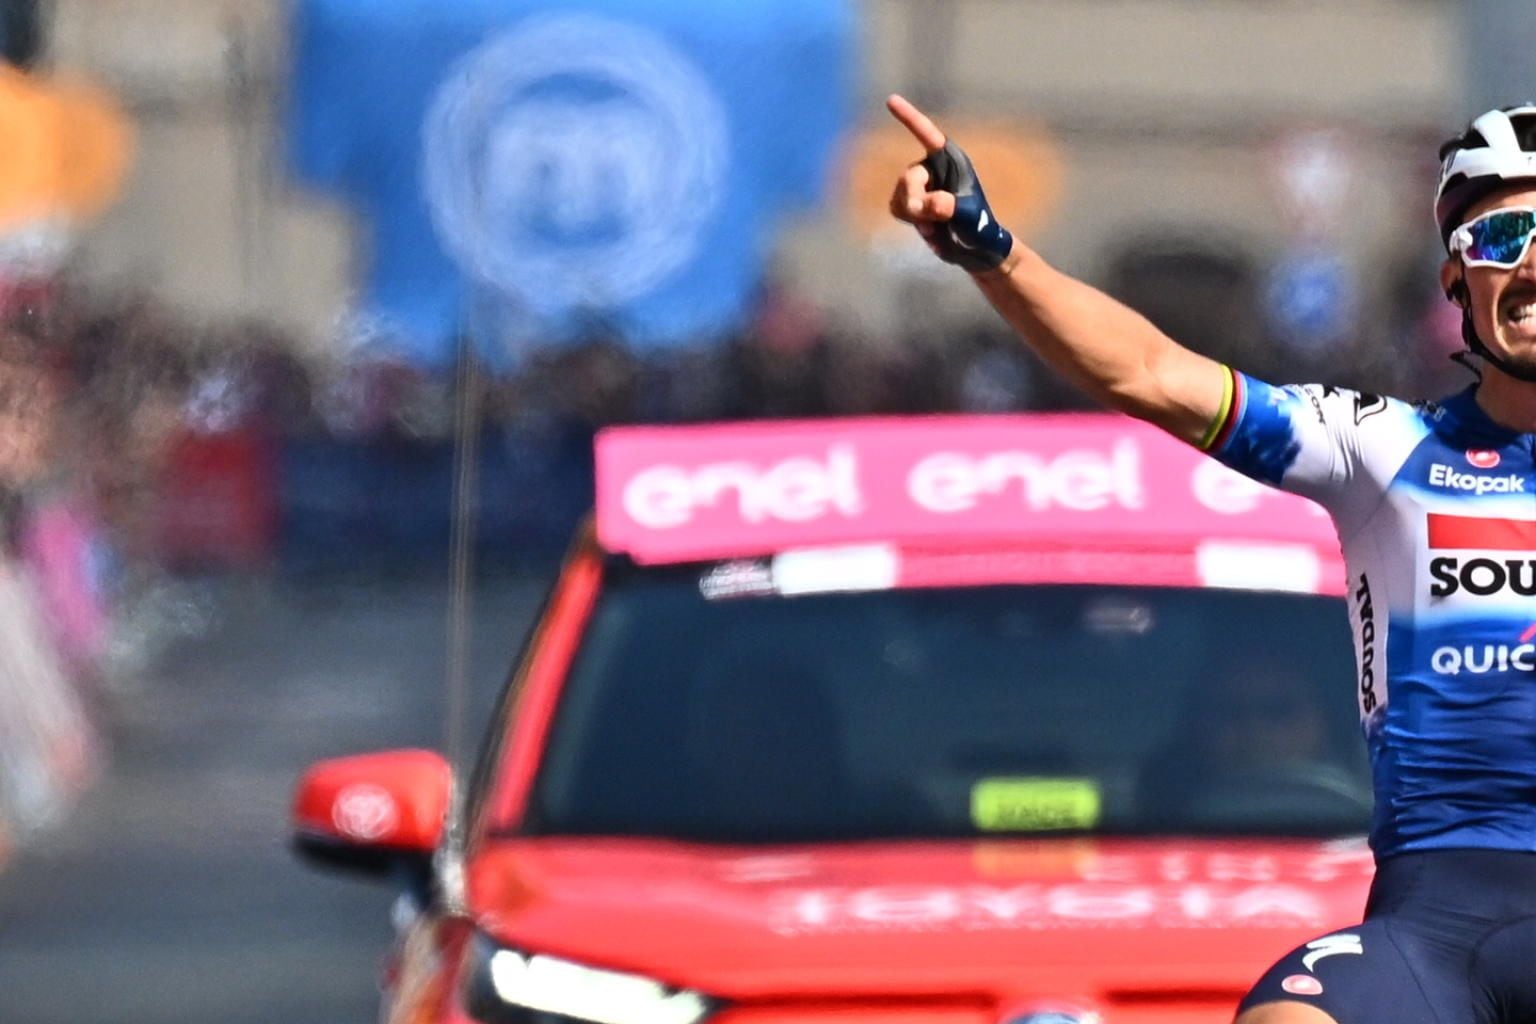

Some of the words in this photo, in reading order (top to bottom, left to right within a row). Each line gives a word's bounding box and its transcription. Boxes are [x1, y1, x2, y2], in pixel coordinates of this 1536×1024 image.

[624, 438, 860, 528] enel
[908, 436, 1143, 513] enel
[1429, 463, 1525, 495] Ekopak
[1356, 572, 1377, 714] SOUDAL
